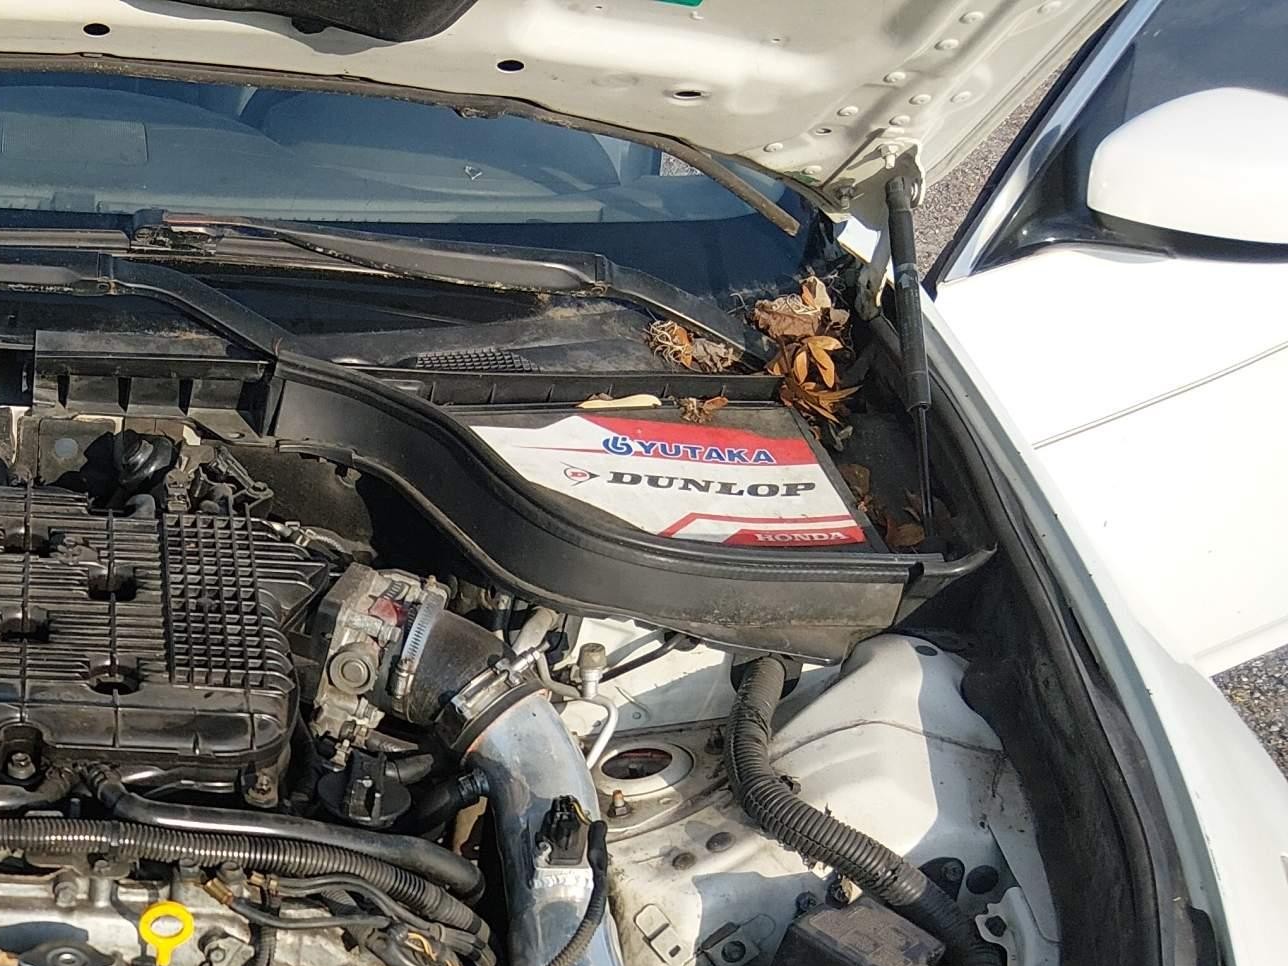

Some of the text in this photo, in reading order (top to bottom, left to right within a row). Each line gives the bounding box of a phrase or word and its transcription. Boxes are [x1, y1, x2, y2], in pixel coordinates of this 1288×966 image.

[637, 441, 776, 464] YUTAKA
[607, 470, 816, 497] DUNLOP
[754, 531, 849, 543] HONDA
